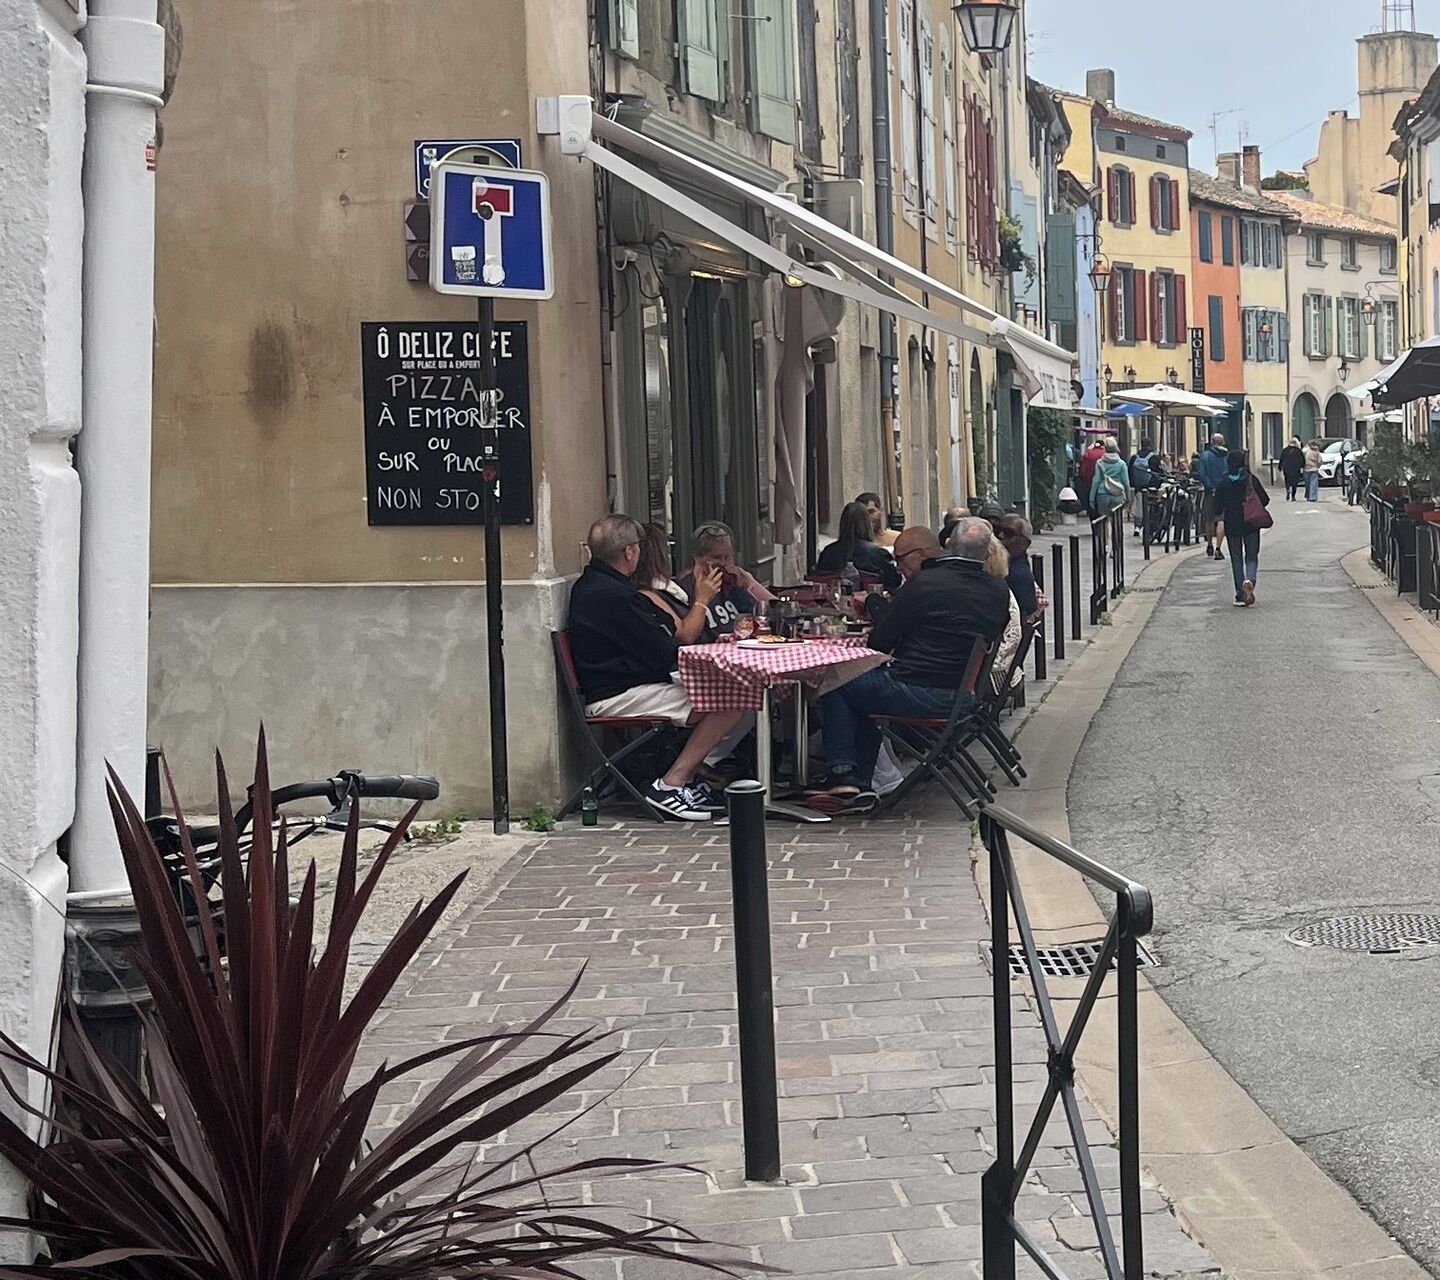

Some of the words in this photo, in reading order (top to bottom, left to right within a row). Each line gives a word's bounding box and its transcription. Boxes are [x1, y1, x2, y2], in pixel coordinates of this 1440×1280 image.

[377, 327, 390, 358] Ô
[399, 331, 454, 358] DELIZ
[462, 331, 513, 358] CE
[1192, 329, 1203, 378] HOTEL
[402, 360, 416, 369] SUR
[417, 360, 437, 369] PLACE
[438, 360, 449, 369] OU
[455, 360, 481, 369] EMPORT
[377, 402, 395, 427] À
[408, 406, 525, 429] EMPORER
[428, 437, 451, 450] OU
[377, 451, 419, 471] SUR
[443, 453, 485, 473] PLAC
[377, 486, 421, 510] NON
[435, 488, 480, 510] STO
